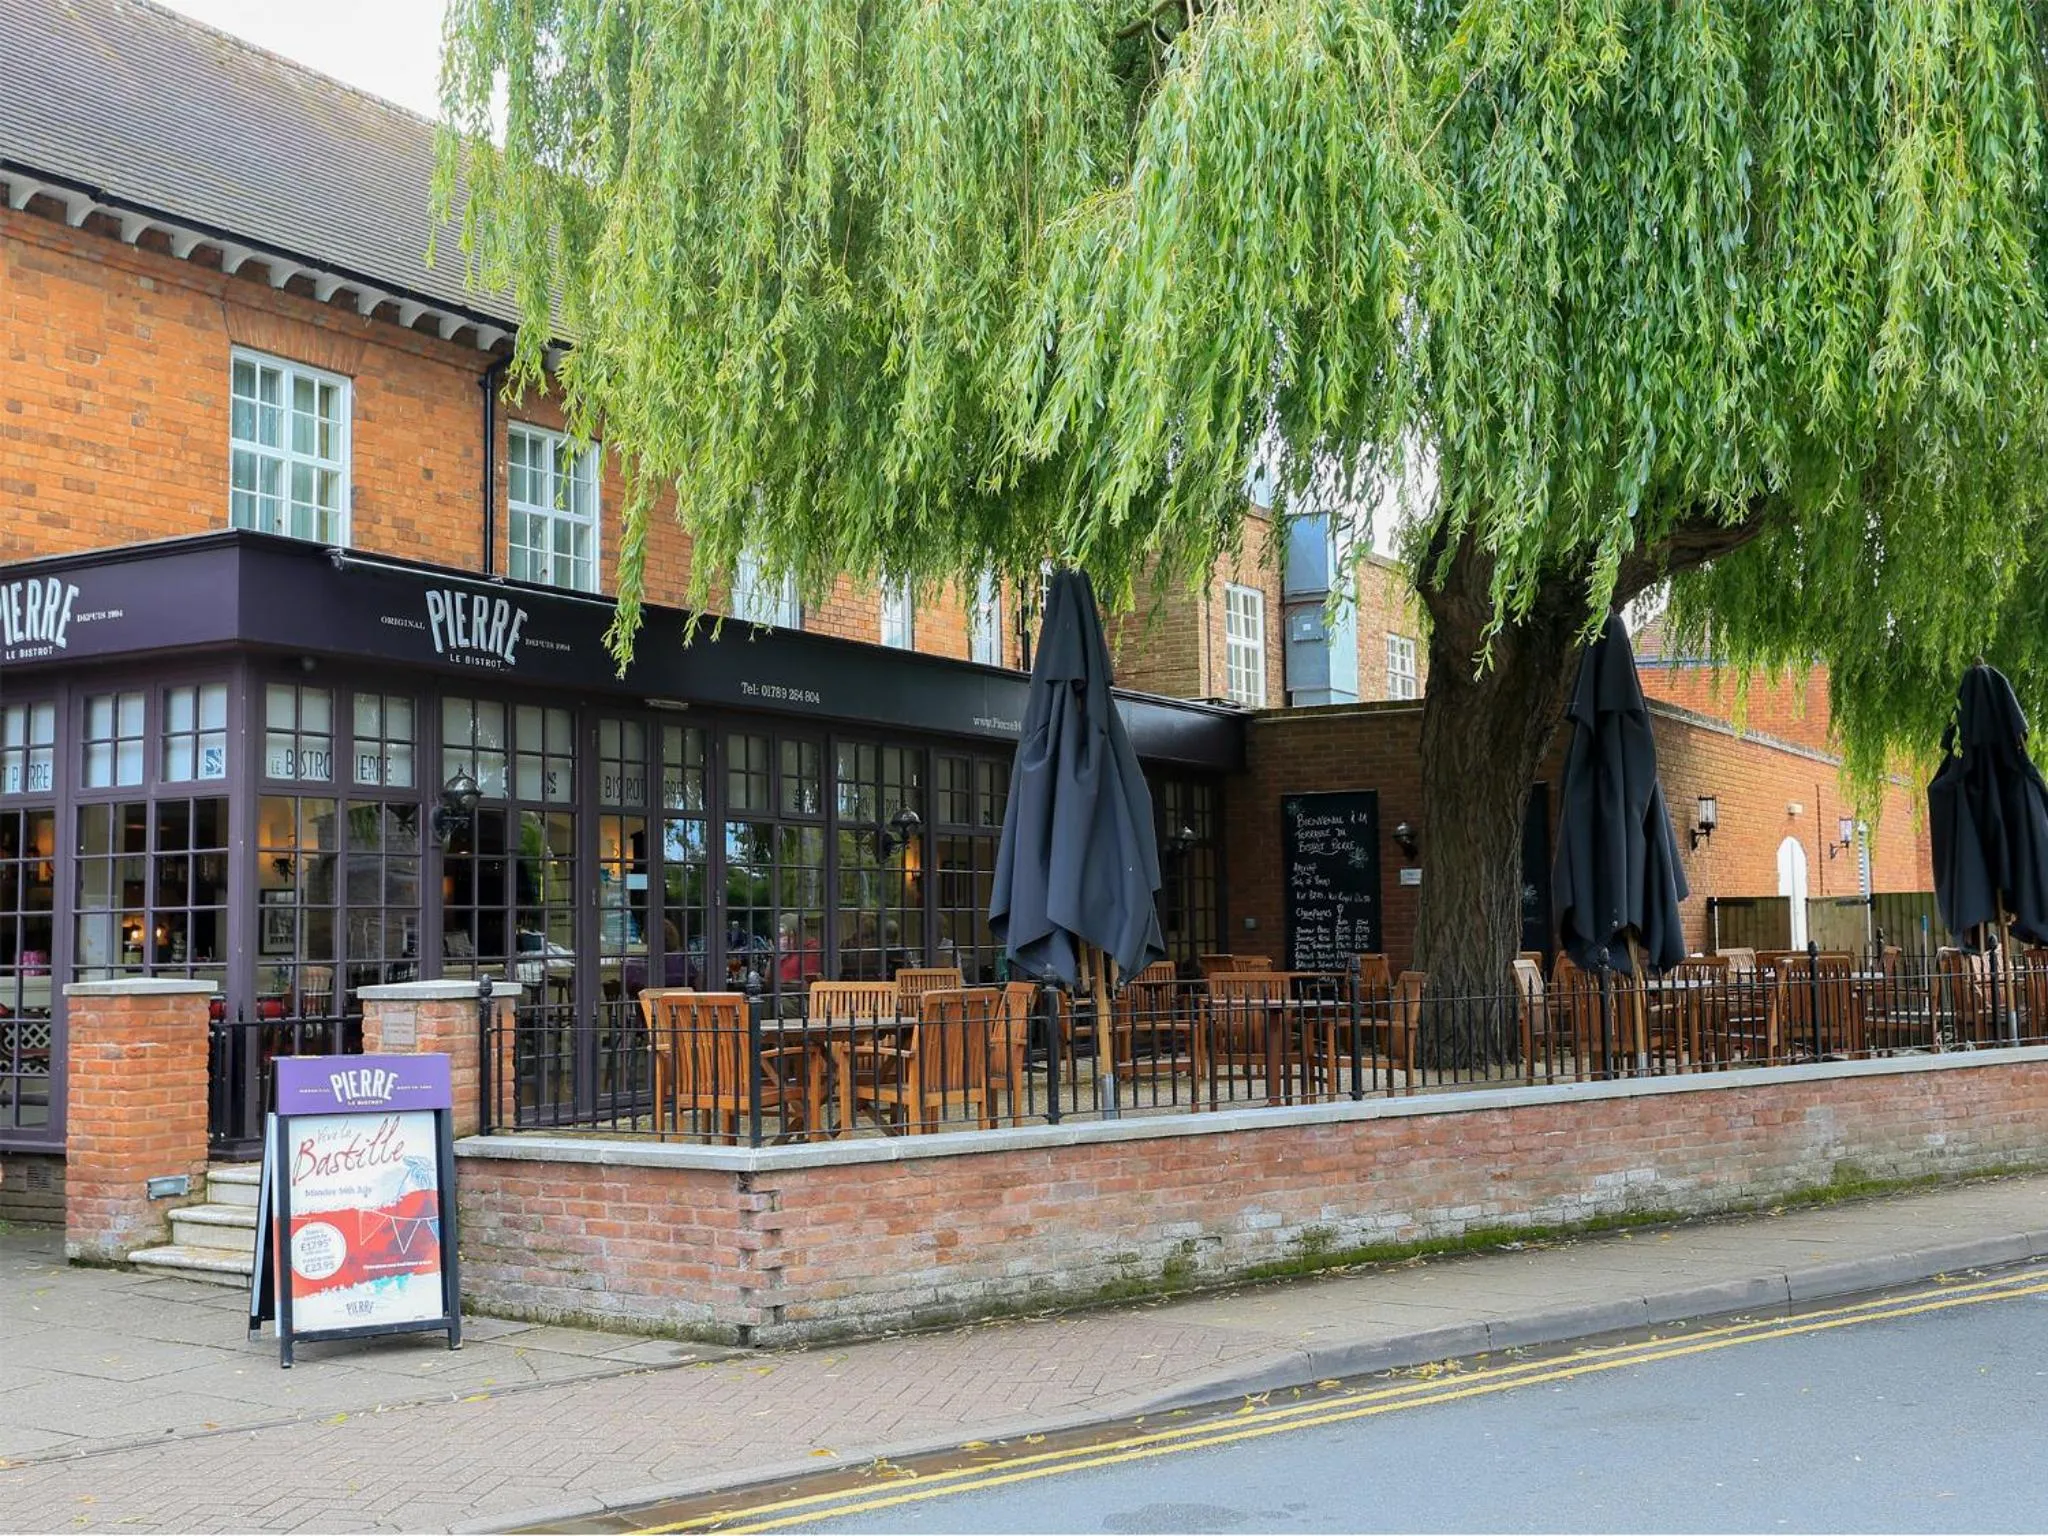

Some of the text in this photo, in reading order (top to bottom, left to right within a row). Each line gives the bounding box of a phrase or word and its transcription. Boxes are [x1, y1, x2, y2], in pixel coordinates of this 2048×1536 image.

[0, 577, 80, 649] IERRE
[380, 615, 426, 630] ORIGINAL
[425, 589, 528, 666] PIERRE
[6, 645, 53, 660] LE BISTROT
[450, 653, 502, 669] LE BISTROT
[329, 1068, 399, 1103] PIERRE
[291, 1115, 405, 1186] Bastille
